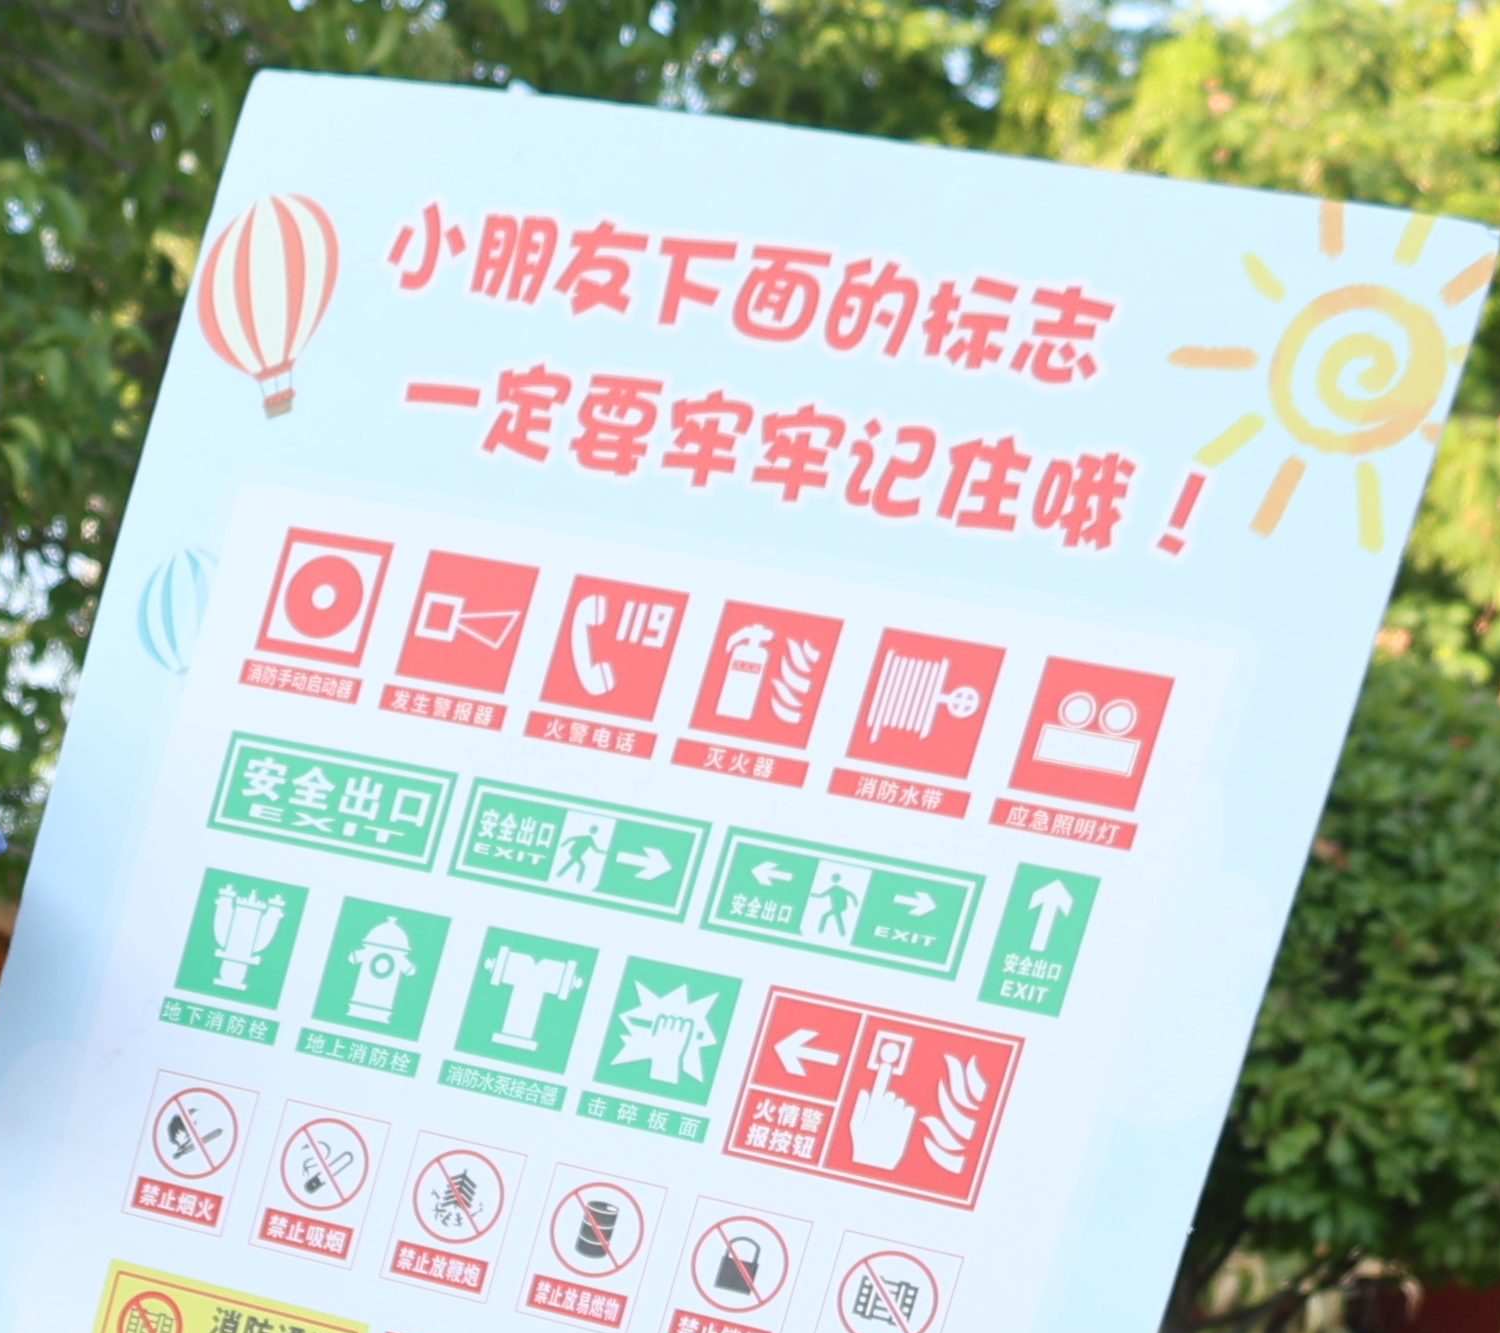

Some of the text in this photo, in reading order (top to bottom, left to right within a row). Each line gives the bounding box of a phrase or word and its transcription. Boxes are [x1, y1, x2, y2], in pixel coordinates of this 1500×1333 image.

[387, 203, 1116, 384] 小朋友下面的标志
[404, 365, 1216, 557] 一定要牢牢记住哦！
[616, 601, 676, 650] 119
[247, 663, 354, 701] 消防手动启动器
[391, 690, 494, 726] 发生警报器
[543, 719, 636, 753] 火警电话
[704, 748, 775, 779] 灭火器
[241, 756, 433, 827] 安全出口
[855, 776, 944, 811] 消防水带
[248, 804, 405, 844] EXIT
[477, 808, 556, 849] 安全出口
[1005, 805, 1120, 844] 应急照明灯
[473, 842, 547, 866] EXIT
[730, 893, 793, 924] 安全出口
[873, 926, 938, 948] EXIT
[1002, 953, 1062, 981] 安全出口
[1000, 980, 1050, 1004] EXIT
[162, 1000, 269, 1042] 地下消防栓
[304, 1033, 412, 1075] 地上消防栓
[446, 1065, 559, 1107] 消防水泵接合器
[586, 1097, 702, 1139] 击碎板面
[752, 1098, 824, 1133] 火情警
[745, 1123, 816, 1159] 报按钮
[139, 1182, 215, 1222] 禁止烟火
[265, 1214, 346, 1254] 禁止吸烟
[395, 1245, 482, 1288] 禁止放鞭炮
[533, 1279, 621, 1323] 禁止放易燃物
